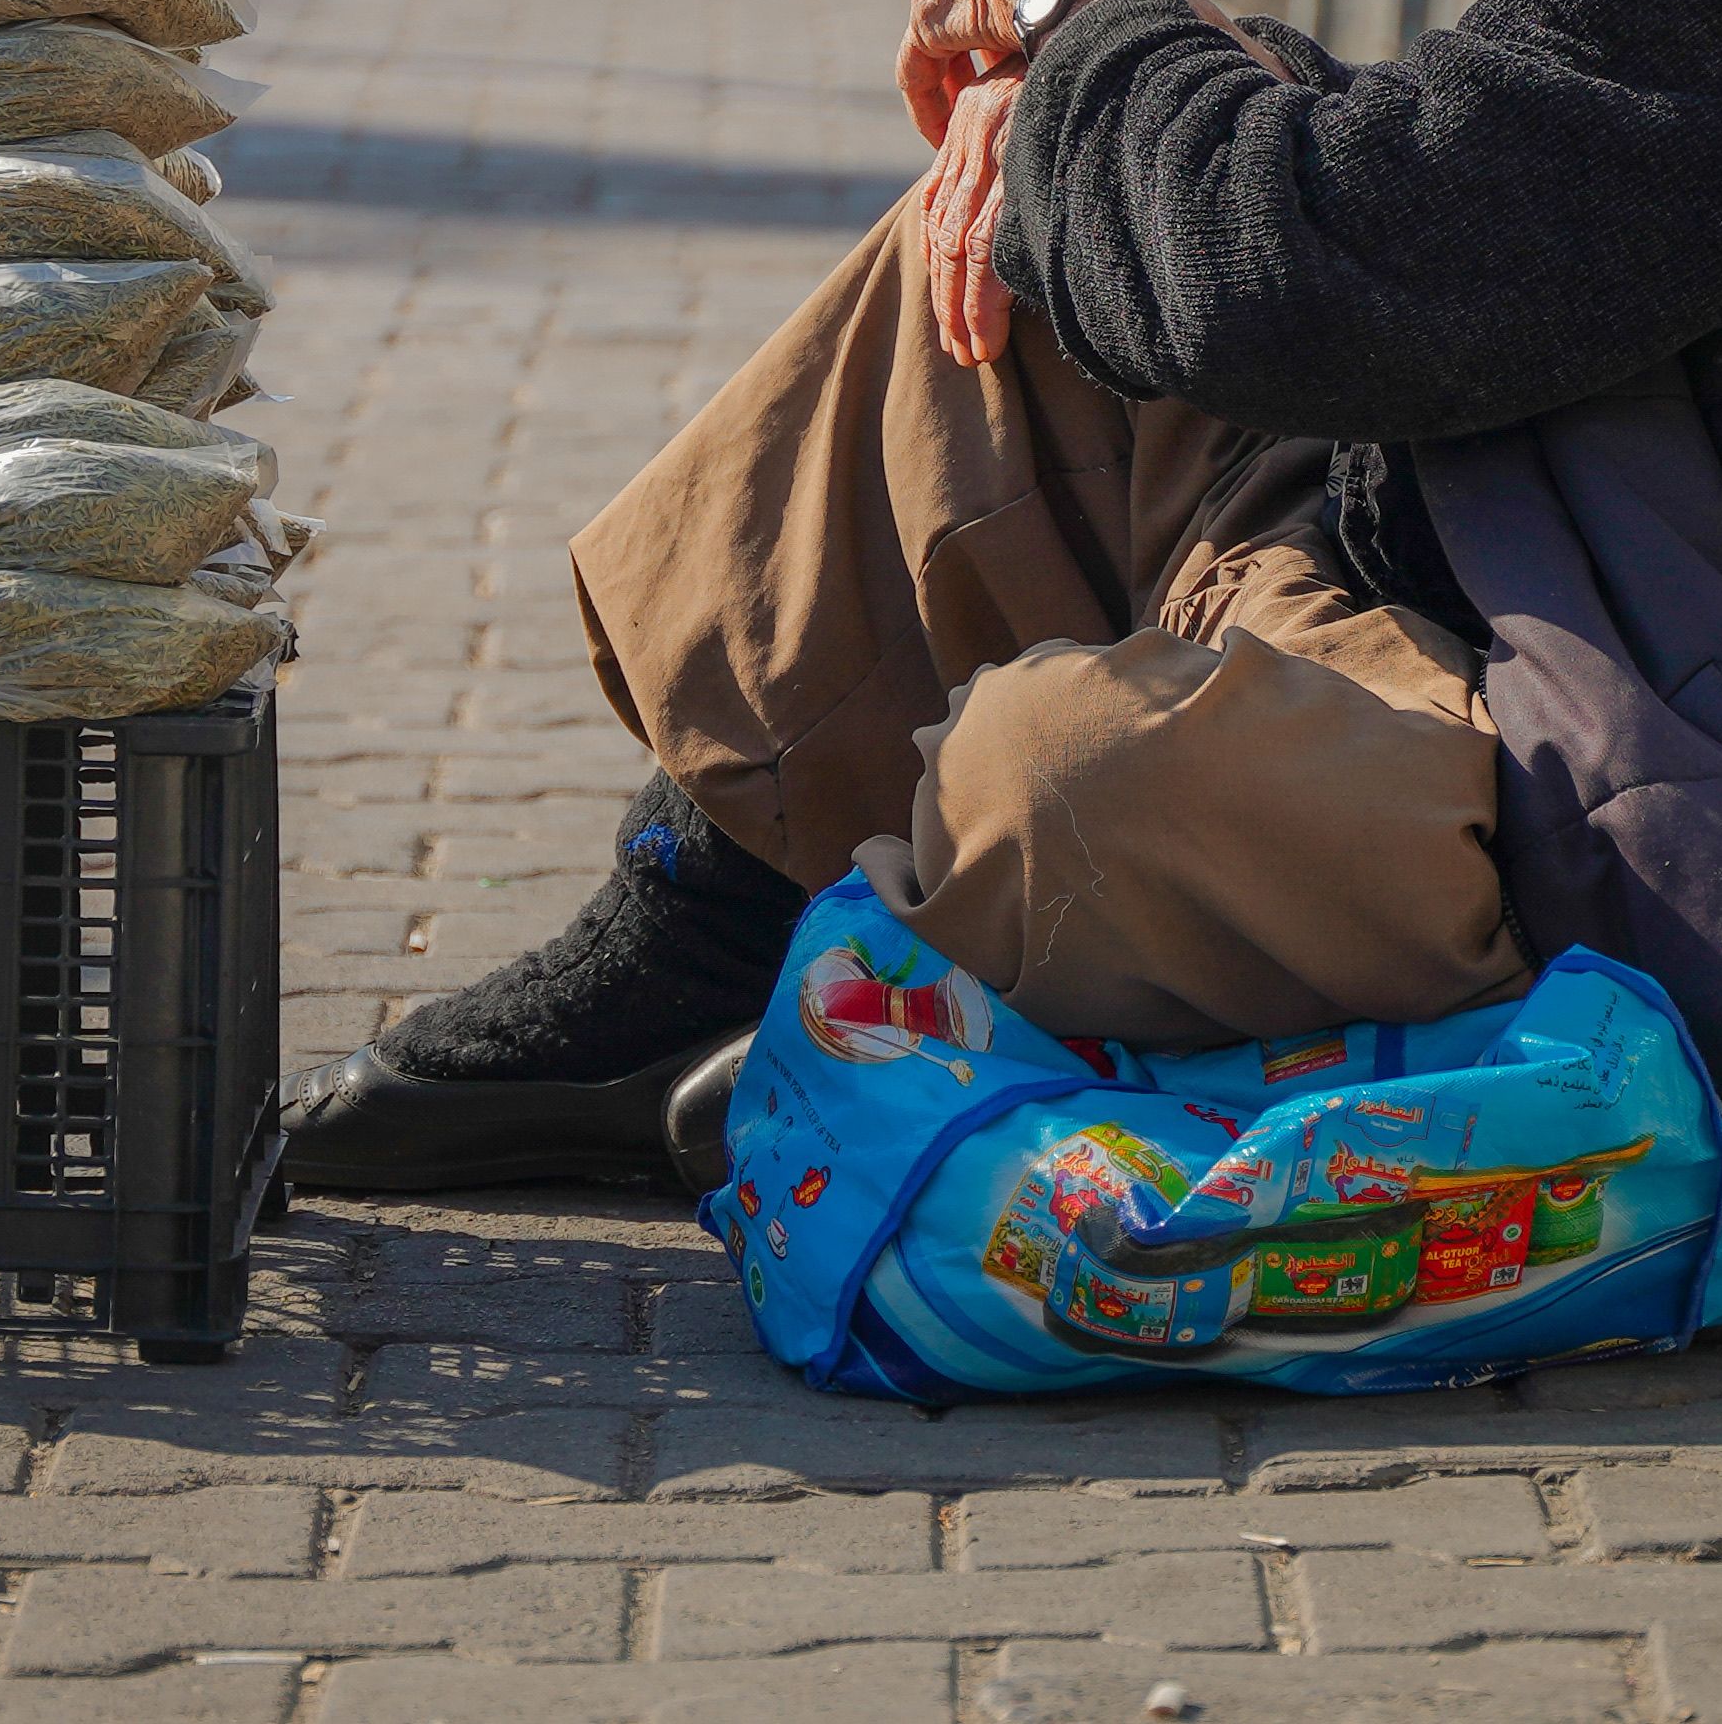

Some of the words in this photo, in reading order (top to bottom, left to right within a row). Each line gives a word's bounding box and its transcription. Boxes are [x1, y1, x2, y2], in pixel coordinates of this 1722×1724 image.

[826, 1133, 842, 1155] TEA
[1426, 1246, 1480, 1261] AL-OTUOR
[1441, 1259, 1462, 1270] TEA
